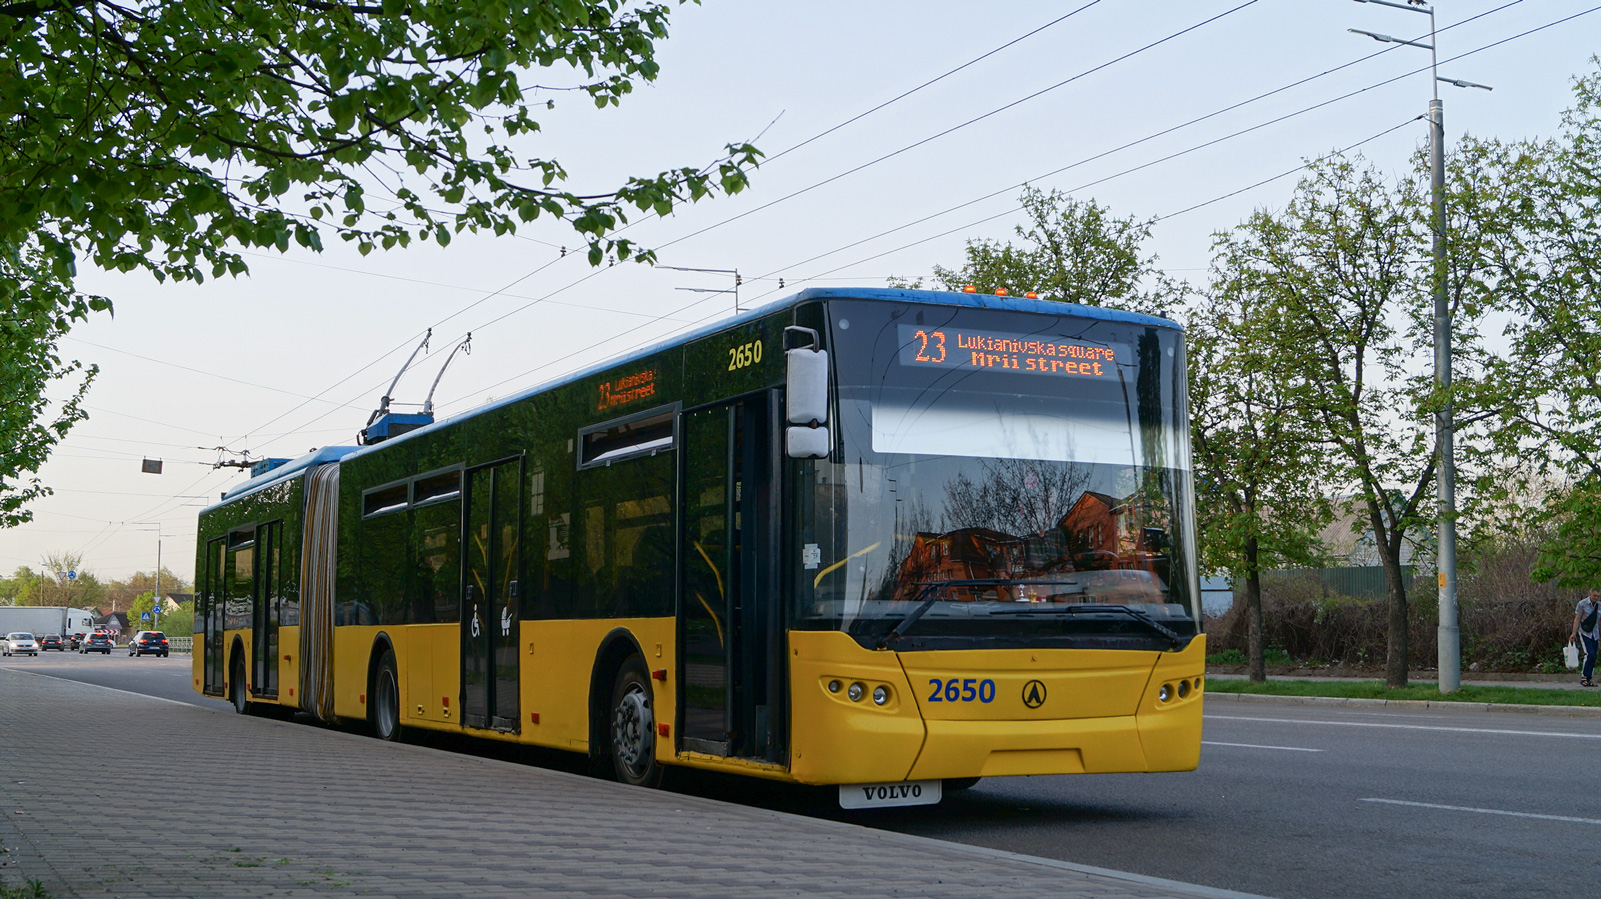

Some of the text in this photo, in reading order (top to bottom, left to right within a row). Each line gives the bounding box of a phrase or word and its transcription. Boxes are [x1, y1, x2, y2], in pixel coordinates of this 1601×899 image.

[728, 339, 763, 372] 2650
[914, 330, 947, 363] 23
[957, 333, 1114, 361] Lukianivska square
[971, 351, 1104, 376] Mrii street
[598, 382, 611, 410] 23
[626, 382, 655, 402] street
[928, 678, 996, 704] 2650
[862, 784, 922, 801] VOLVO
